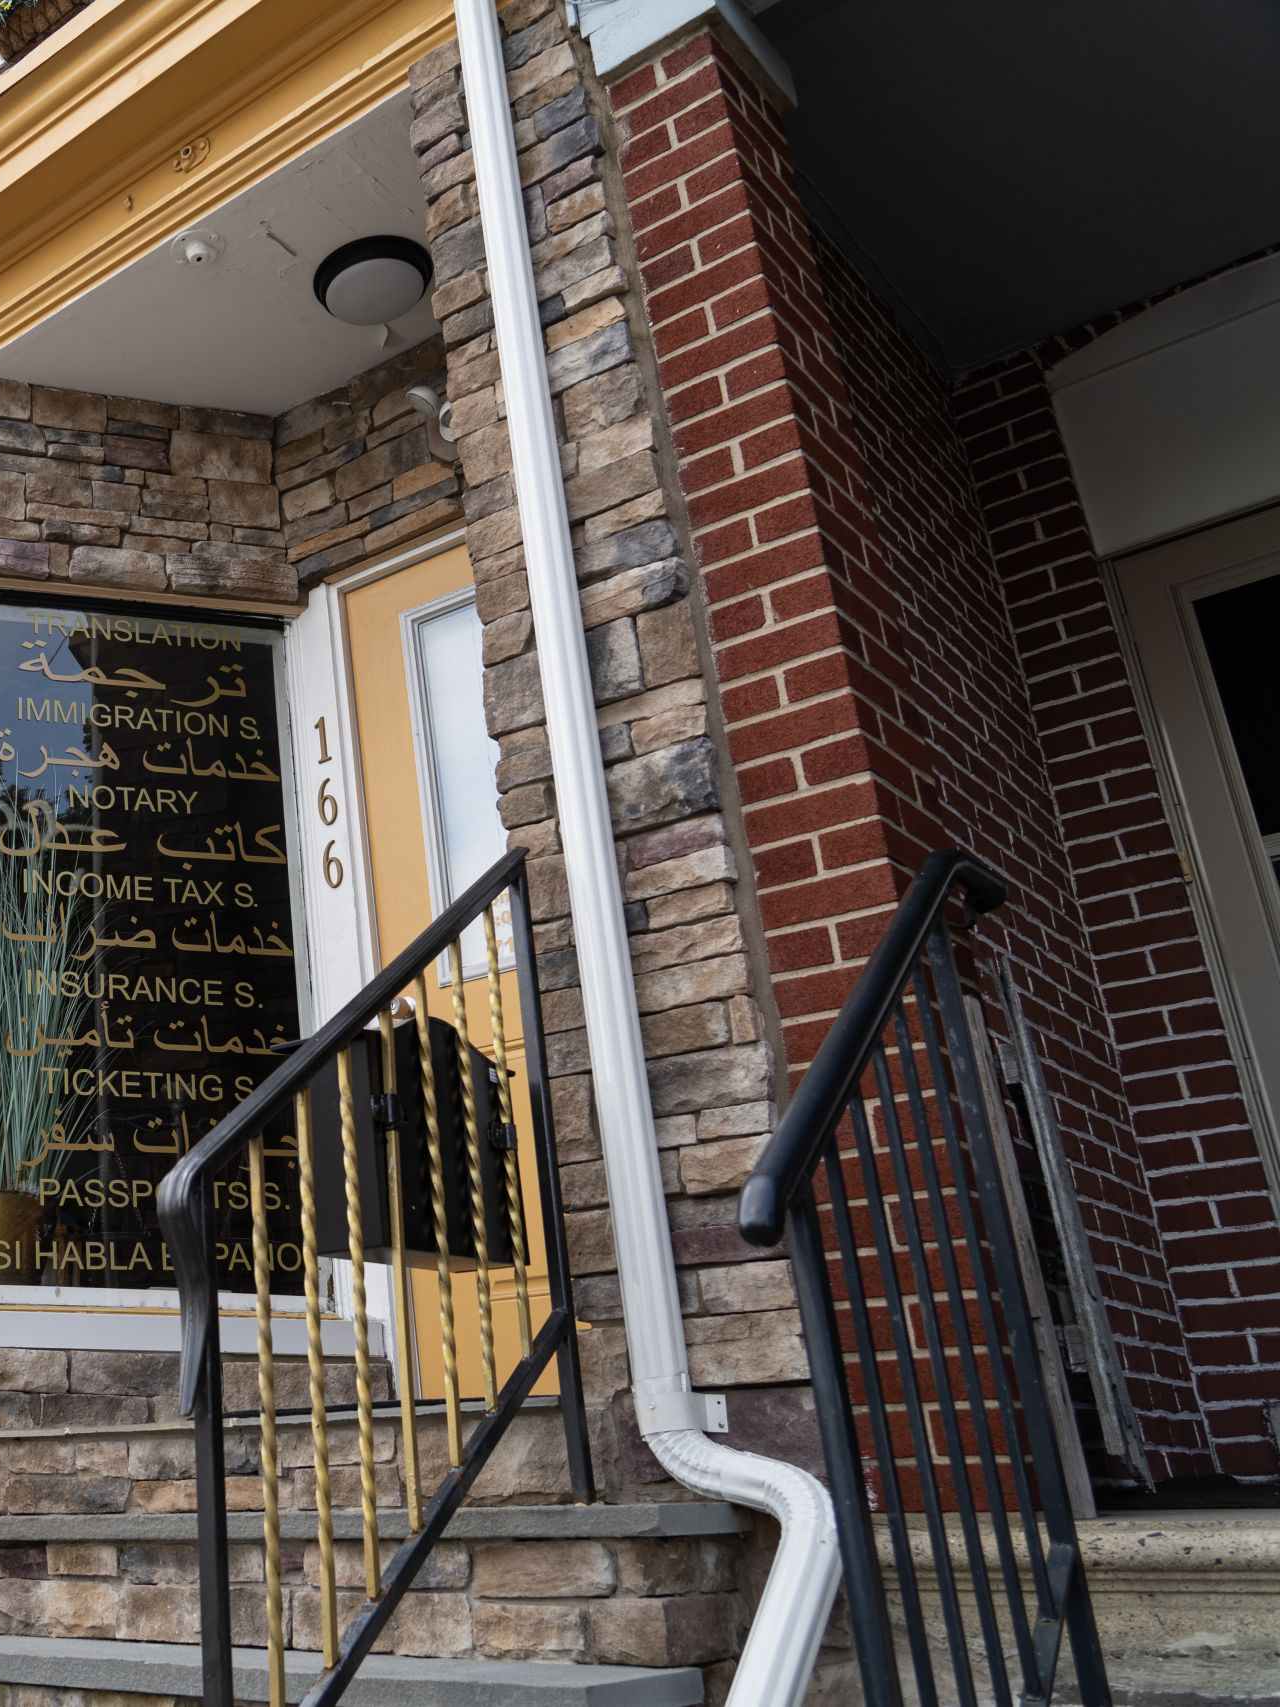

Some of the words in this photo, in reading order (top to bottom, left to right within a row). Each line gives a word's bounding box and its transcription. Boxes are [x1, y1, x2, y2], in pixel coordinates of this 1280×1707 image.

[27, 612, 242, 652] TRANSLATION
[17, 697, 229, 737] IMMIGRATION
[240, 717, 261, 740] S.
[142, 738, 280, 782] خدمات
[69, 784, 198, 814] NOTARY
[314, 716, 343, 888] 166
[0, 806, 127, 857] عدل
[156, 821, 287, 871] كاتب
[23, 869, 154, 902] INCOME
[163, 878, 225, 906] TAX
[235, 883, 258, 908] S.
[171, 911, 294, 957] خدمات
[26, 969, 225, 1006] INSURANCE
[234, 982, 264, 1009] S.
[153, 1014, 292, 1056] خدمات
[40, 1067, 224, 1101] TICKETING
[234, 1076, 256, 1102] S
[40, 1179, 249, 1210] PASSPTS
[35, 1241, 152, 1271] HABLA
